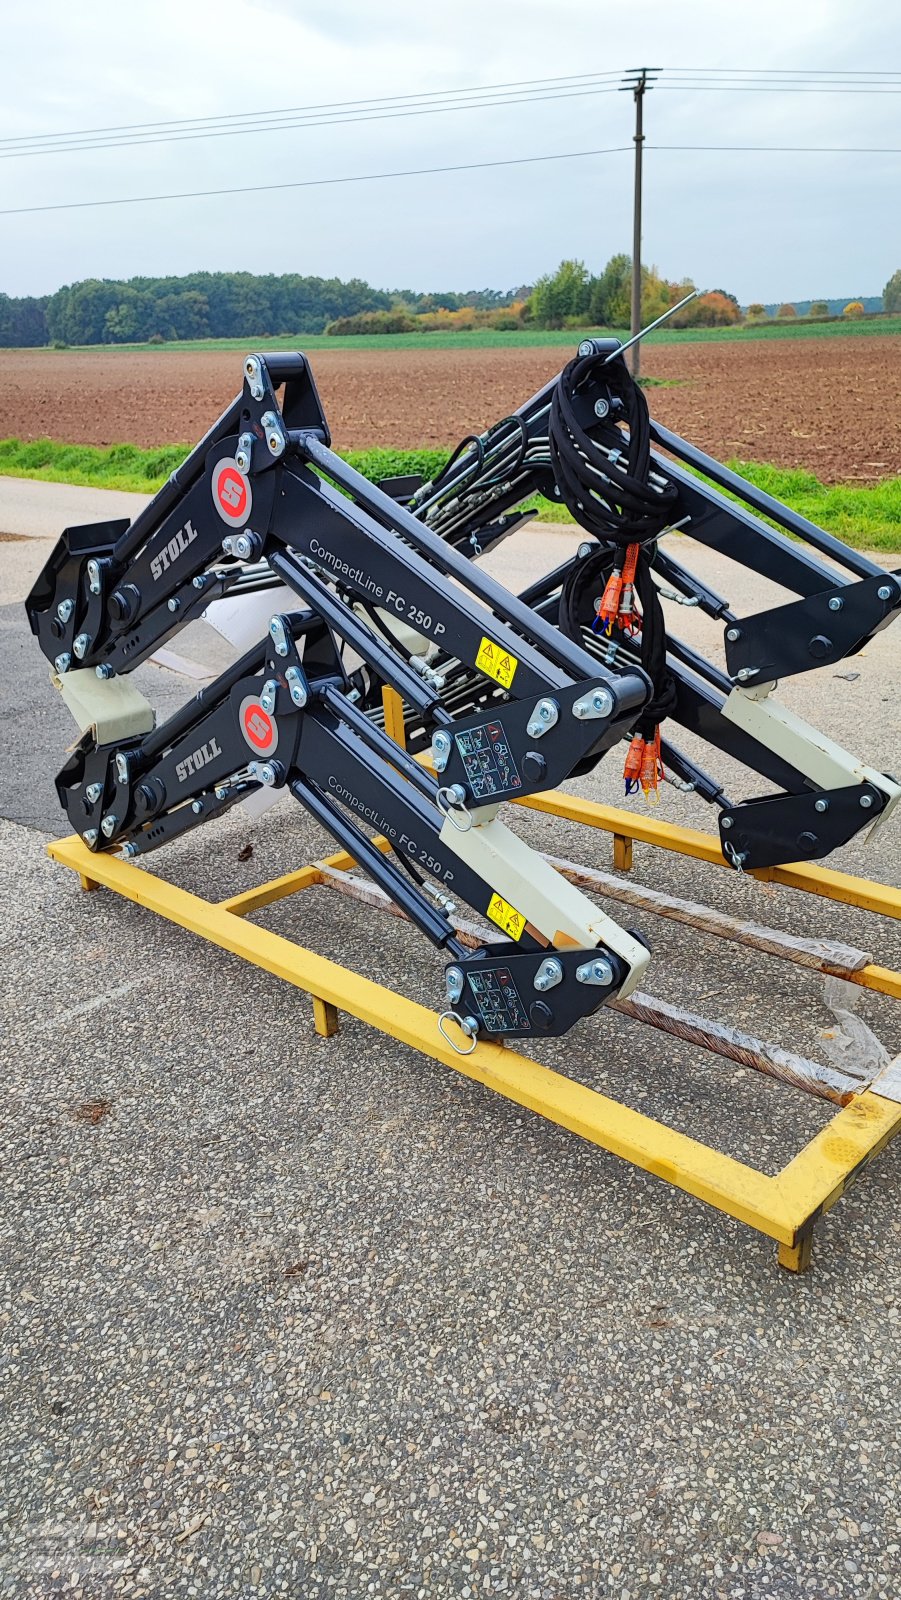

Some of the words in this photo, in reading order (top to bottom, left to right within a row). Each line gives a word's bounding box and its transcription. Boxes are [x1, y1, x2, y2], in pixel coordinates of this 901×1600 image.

[149, 520, 198, 581] STOLL
[309, 539, 383, 597] CompactLine
[385, 590, 406, 612] FC
[407, 605, 432, 630] 250
[433, 623, 446, 635] P
[175, 737, 222, 783] STOLL
[328, 775, 397, 837] CompactLine
[398, 833, 417, 853] FC
[418, 850, 442, 873] 250
[443, 870, 454, 881] P
